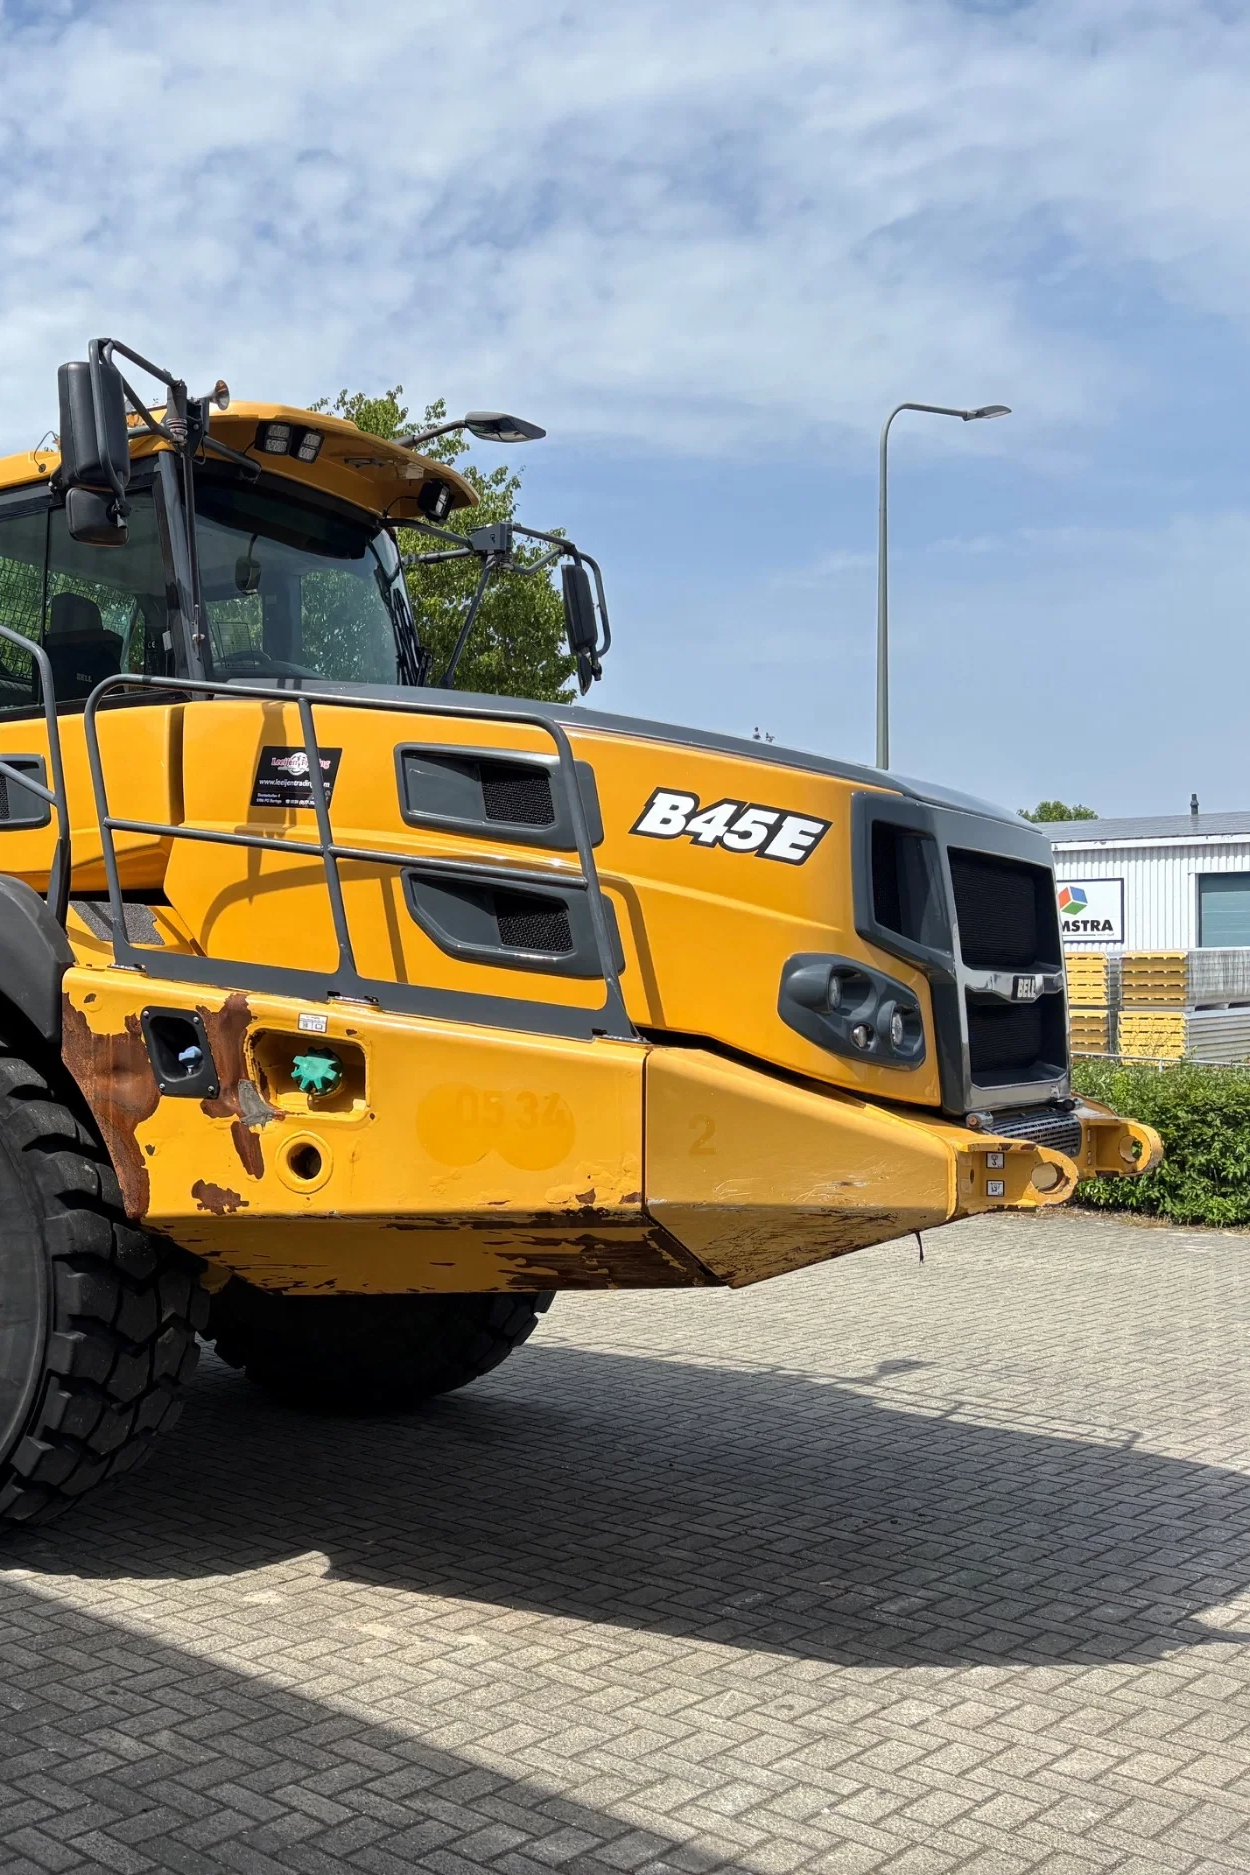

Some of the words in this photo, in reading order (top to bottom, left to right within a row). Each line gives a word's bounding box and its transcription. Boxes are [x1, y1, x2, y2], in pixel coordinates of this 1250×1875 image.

[259, 778, 330, 789] www.leeijentradinm
[632, 790, 829, 863] B45E
[1017, 978, 1036, 998] BELL
